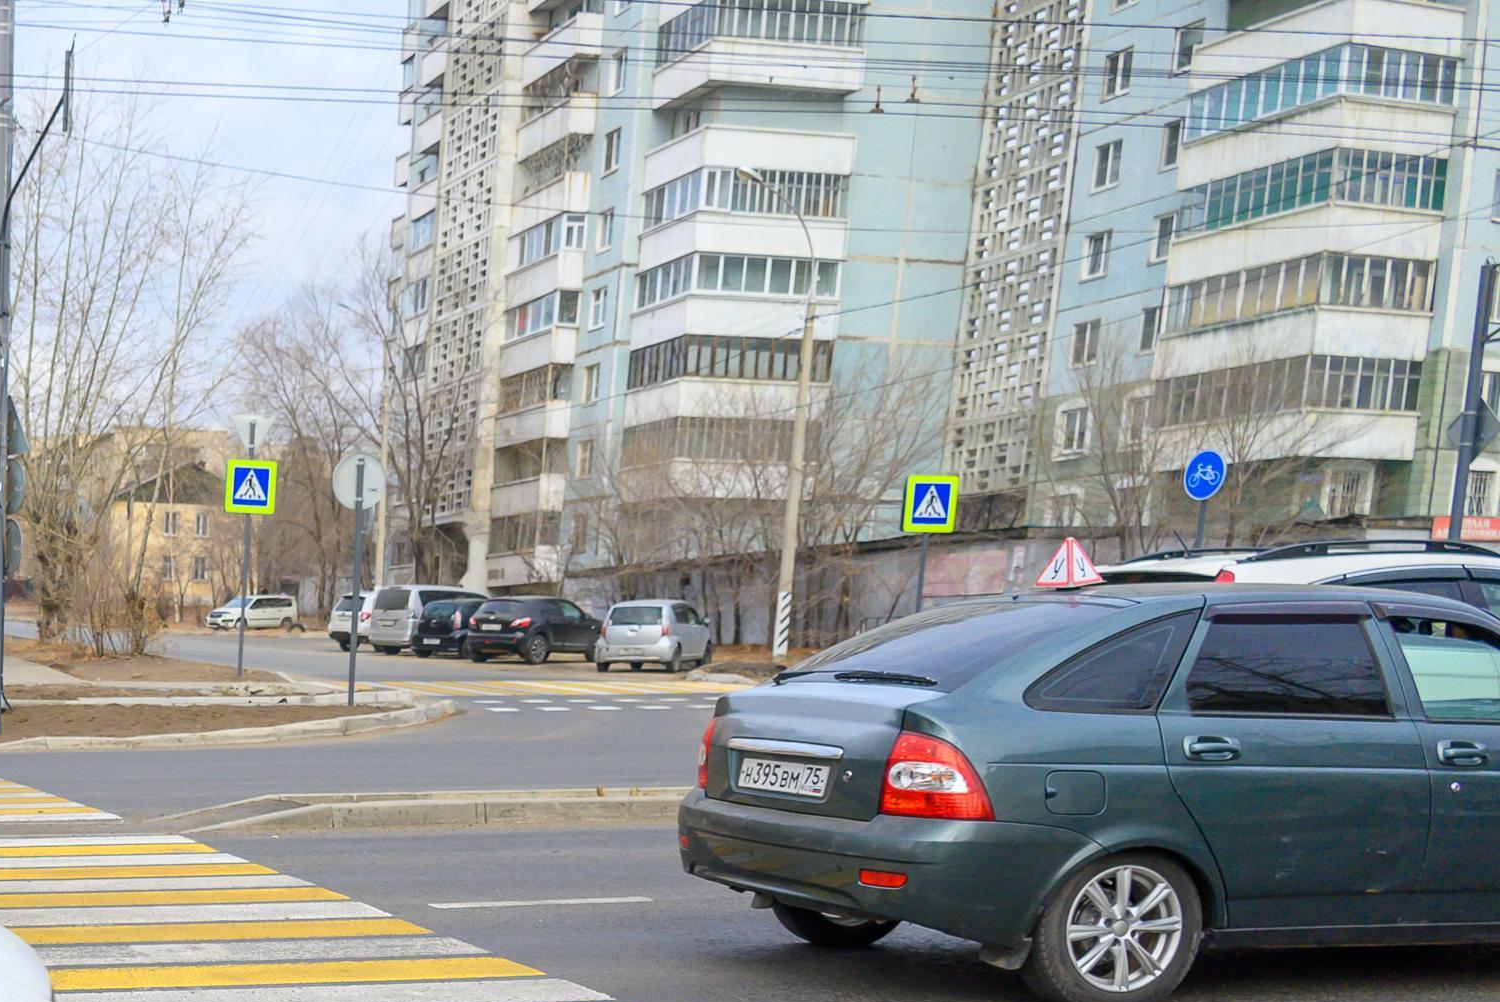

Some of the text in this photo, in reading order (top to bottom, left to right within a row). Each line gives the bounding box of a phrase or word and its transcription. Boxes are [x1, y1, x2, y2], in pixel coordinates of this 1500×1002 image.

[1051, 558, 1065, 580] У
[1075, 557, 1086, 577] У
[744, 763, 823, 790] Н395ВМ 75
